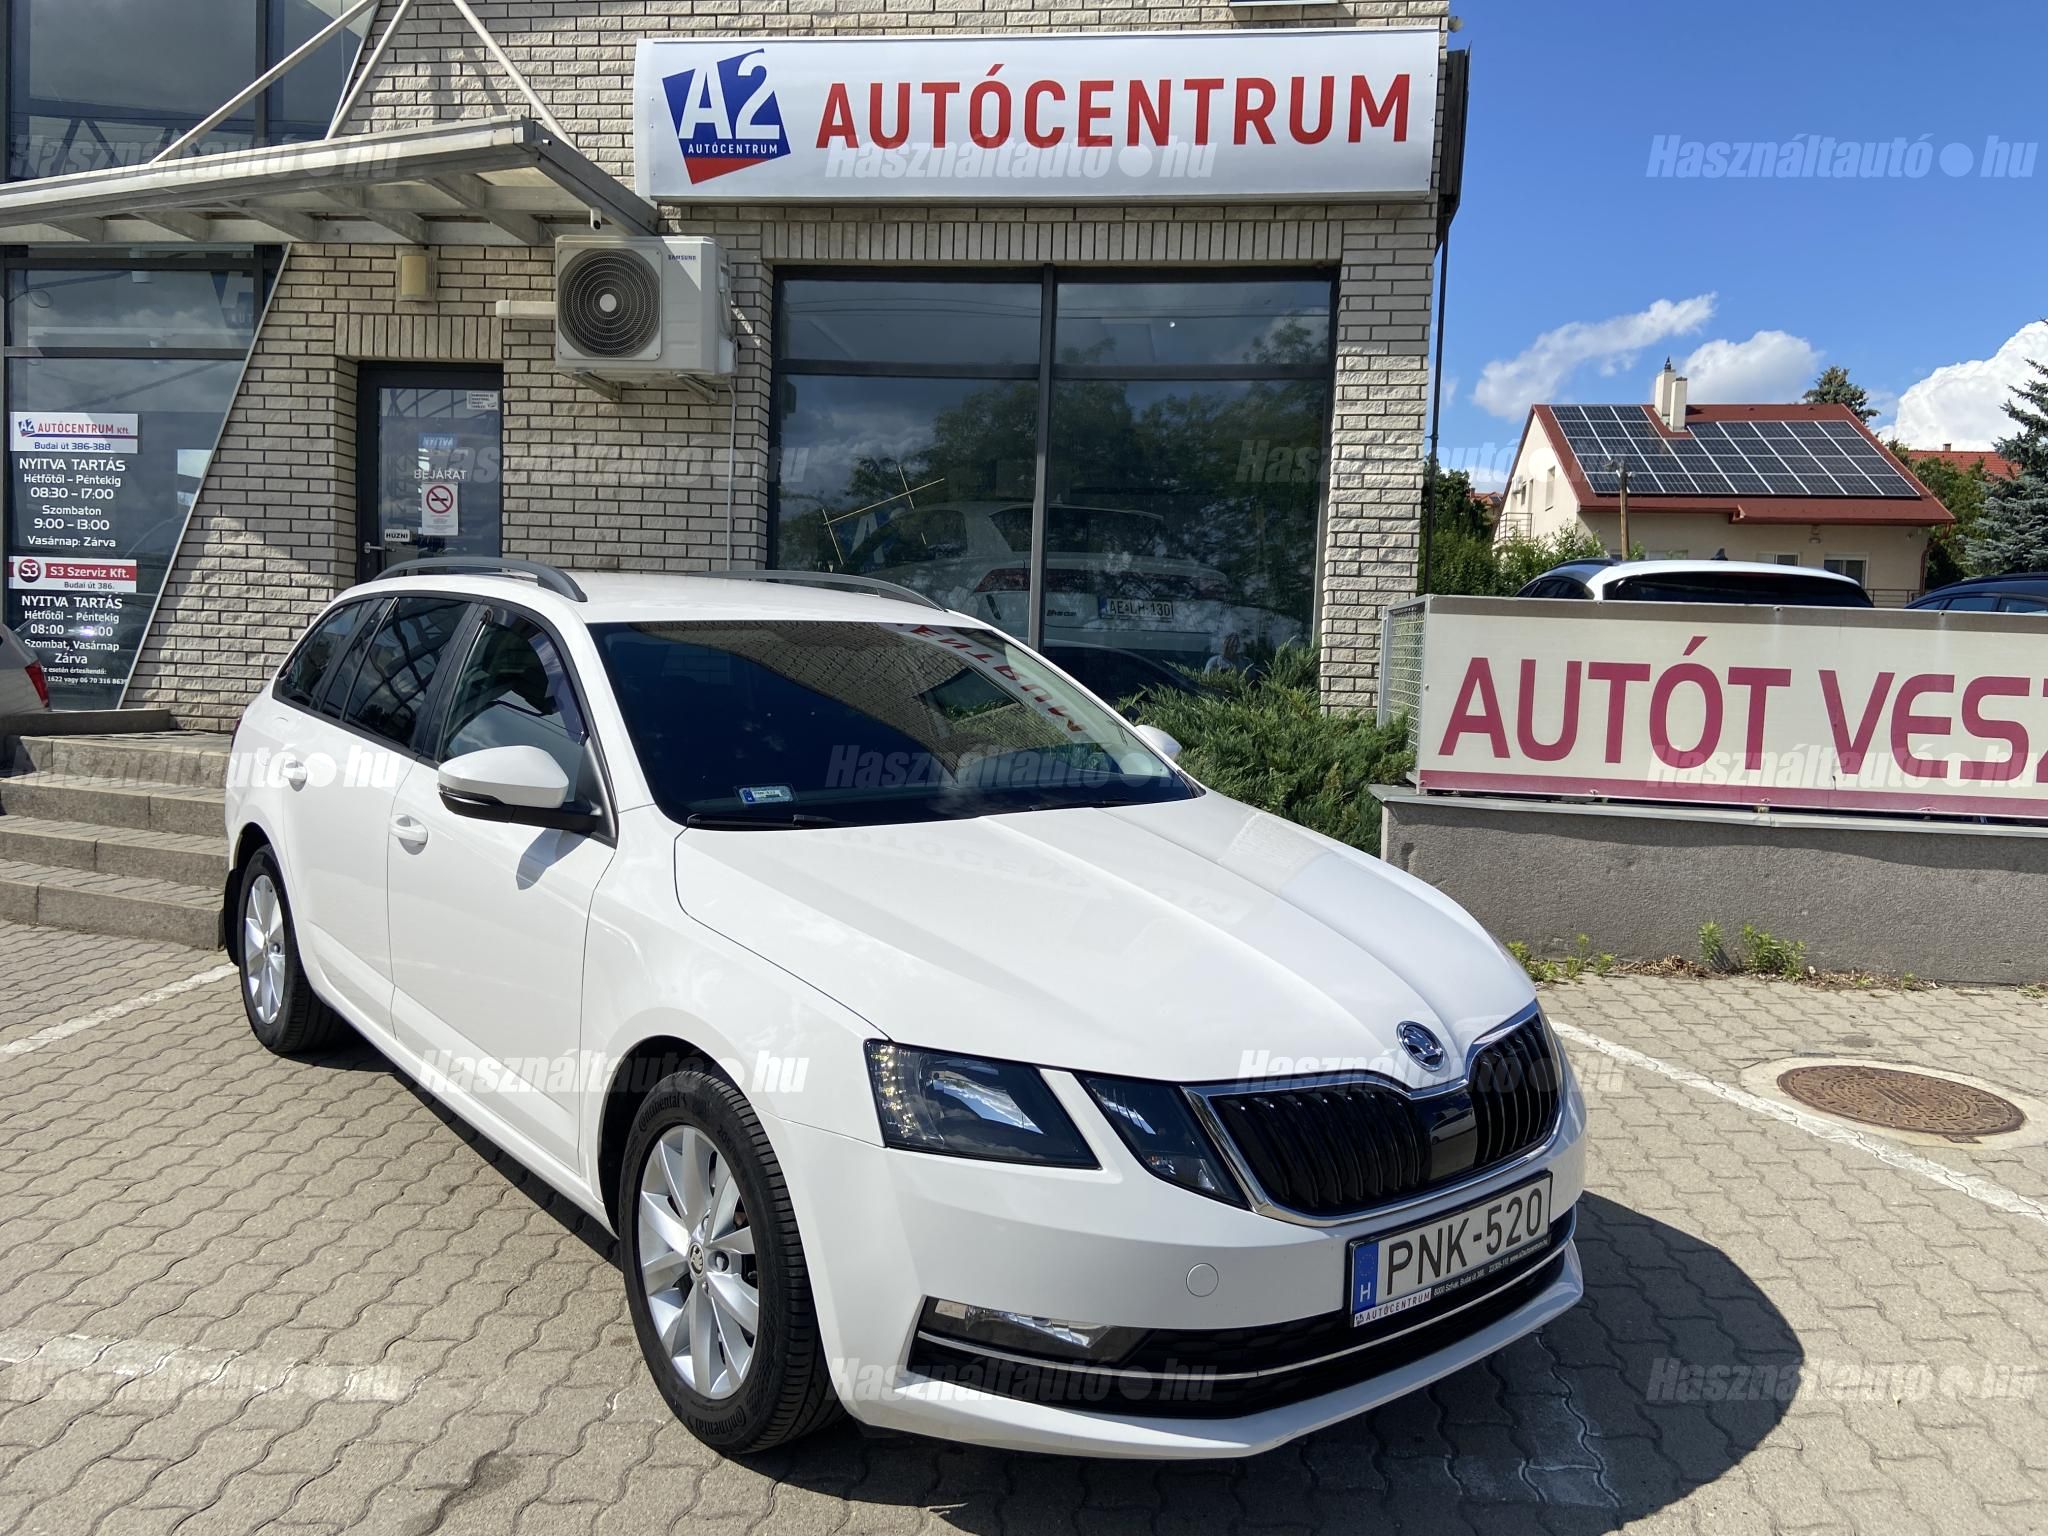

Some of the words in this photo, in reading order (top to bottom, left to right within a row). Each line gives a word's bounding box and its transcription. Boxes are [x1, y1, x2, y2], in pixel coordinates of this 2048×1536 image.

[678, 51, 780, 140] A2
[815, 64, 1411, 150] AUTÓCENTRUM
[687, 142, 778, 155] AUTÓCENTRUM
[38, 421, 114, 434] AUTÓCENTRUM
[34, 442, 59, 450] Budai
[60, 442, 70, 450] út
[19, 458, 67, 470] NYITVA
[71, 457, 126, 472] TARTÁS
[23, 473, 65, 484] Hétfőtől
[76, 475, 121, 487] Péntekig
[414, 467, 467, 480] BEJÁRAT
[30, 487, 69, 498] 08:30
[81, 488, 114, 500] 17:00
[42, 504, 102, 516] Szombaton
[33, 518, 65, 529] 9:00
[77, 519, 110, 531] 13:00
[27, 535, 81, 547] Vasárnap:
[83, 537, 116, 547] Zárva
[50, 566, 65, 576] S3
[67, 566, 107, 577] Szerviz
[110, 568, 130, 578] Kft.
[64, 581, 86, 589] Budai
[21, 595, 69, 607] NYITVA
[73, 595, 123, 609] TARTÁS
[24, 610, 64, 621] Hétfőtől
[76, 612, 120, 624] Péntekig
[30, 624, 65, 635] 08:00
[24, 639, 70, 651] Szombat,
[72, 641, 120, 653] Vasárnap
[55, 652, 88, 664] Zárva
[1437, 636, 1792, 771] AUTÓT
[1817, 670, 2048, 784] VES
[1386, 1188, 1543, 1296] PNK-520
[1359, 1282, 1372, 1303] H
[1365, 1291, 1431, 1321] AUTÓCENTRUM
